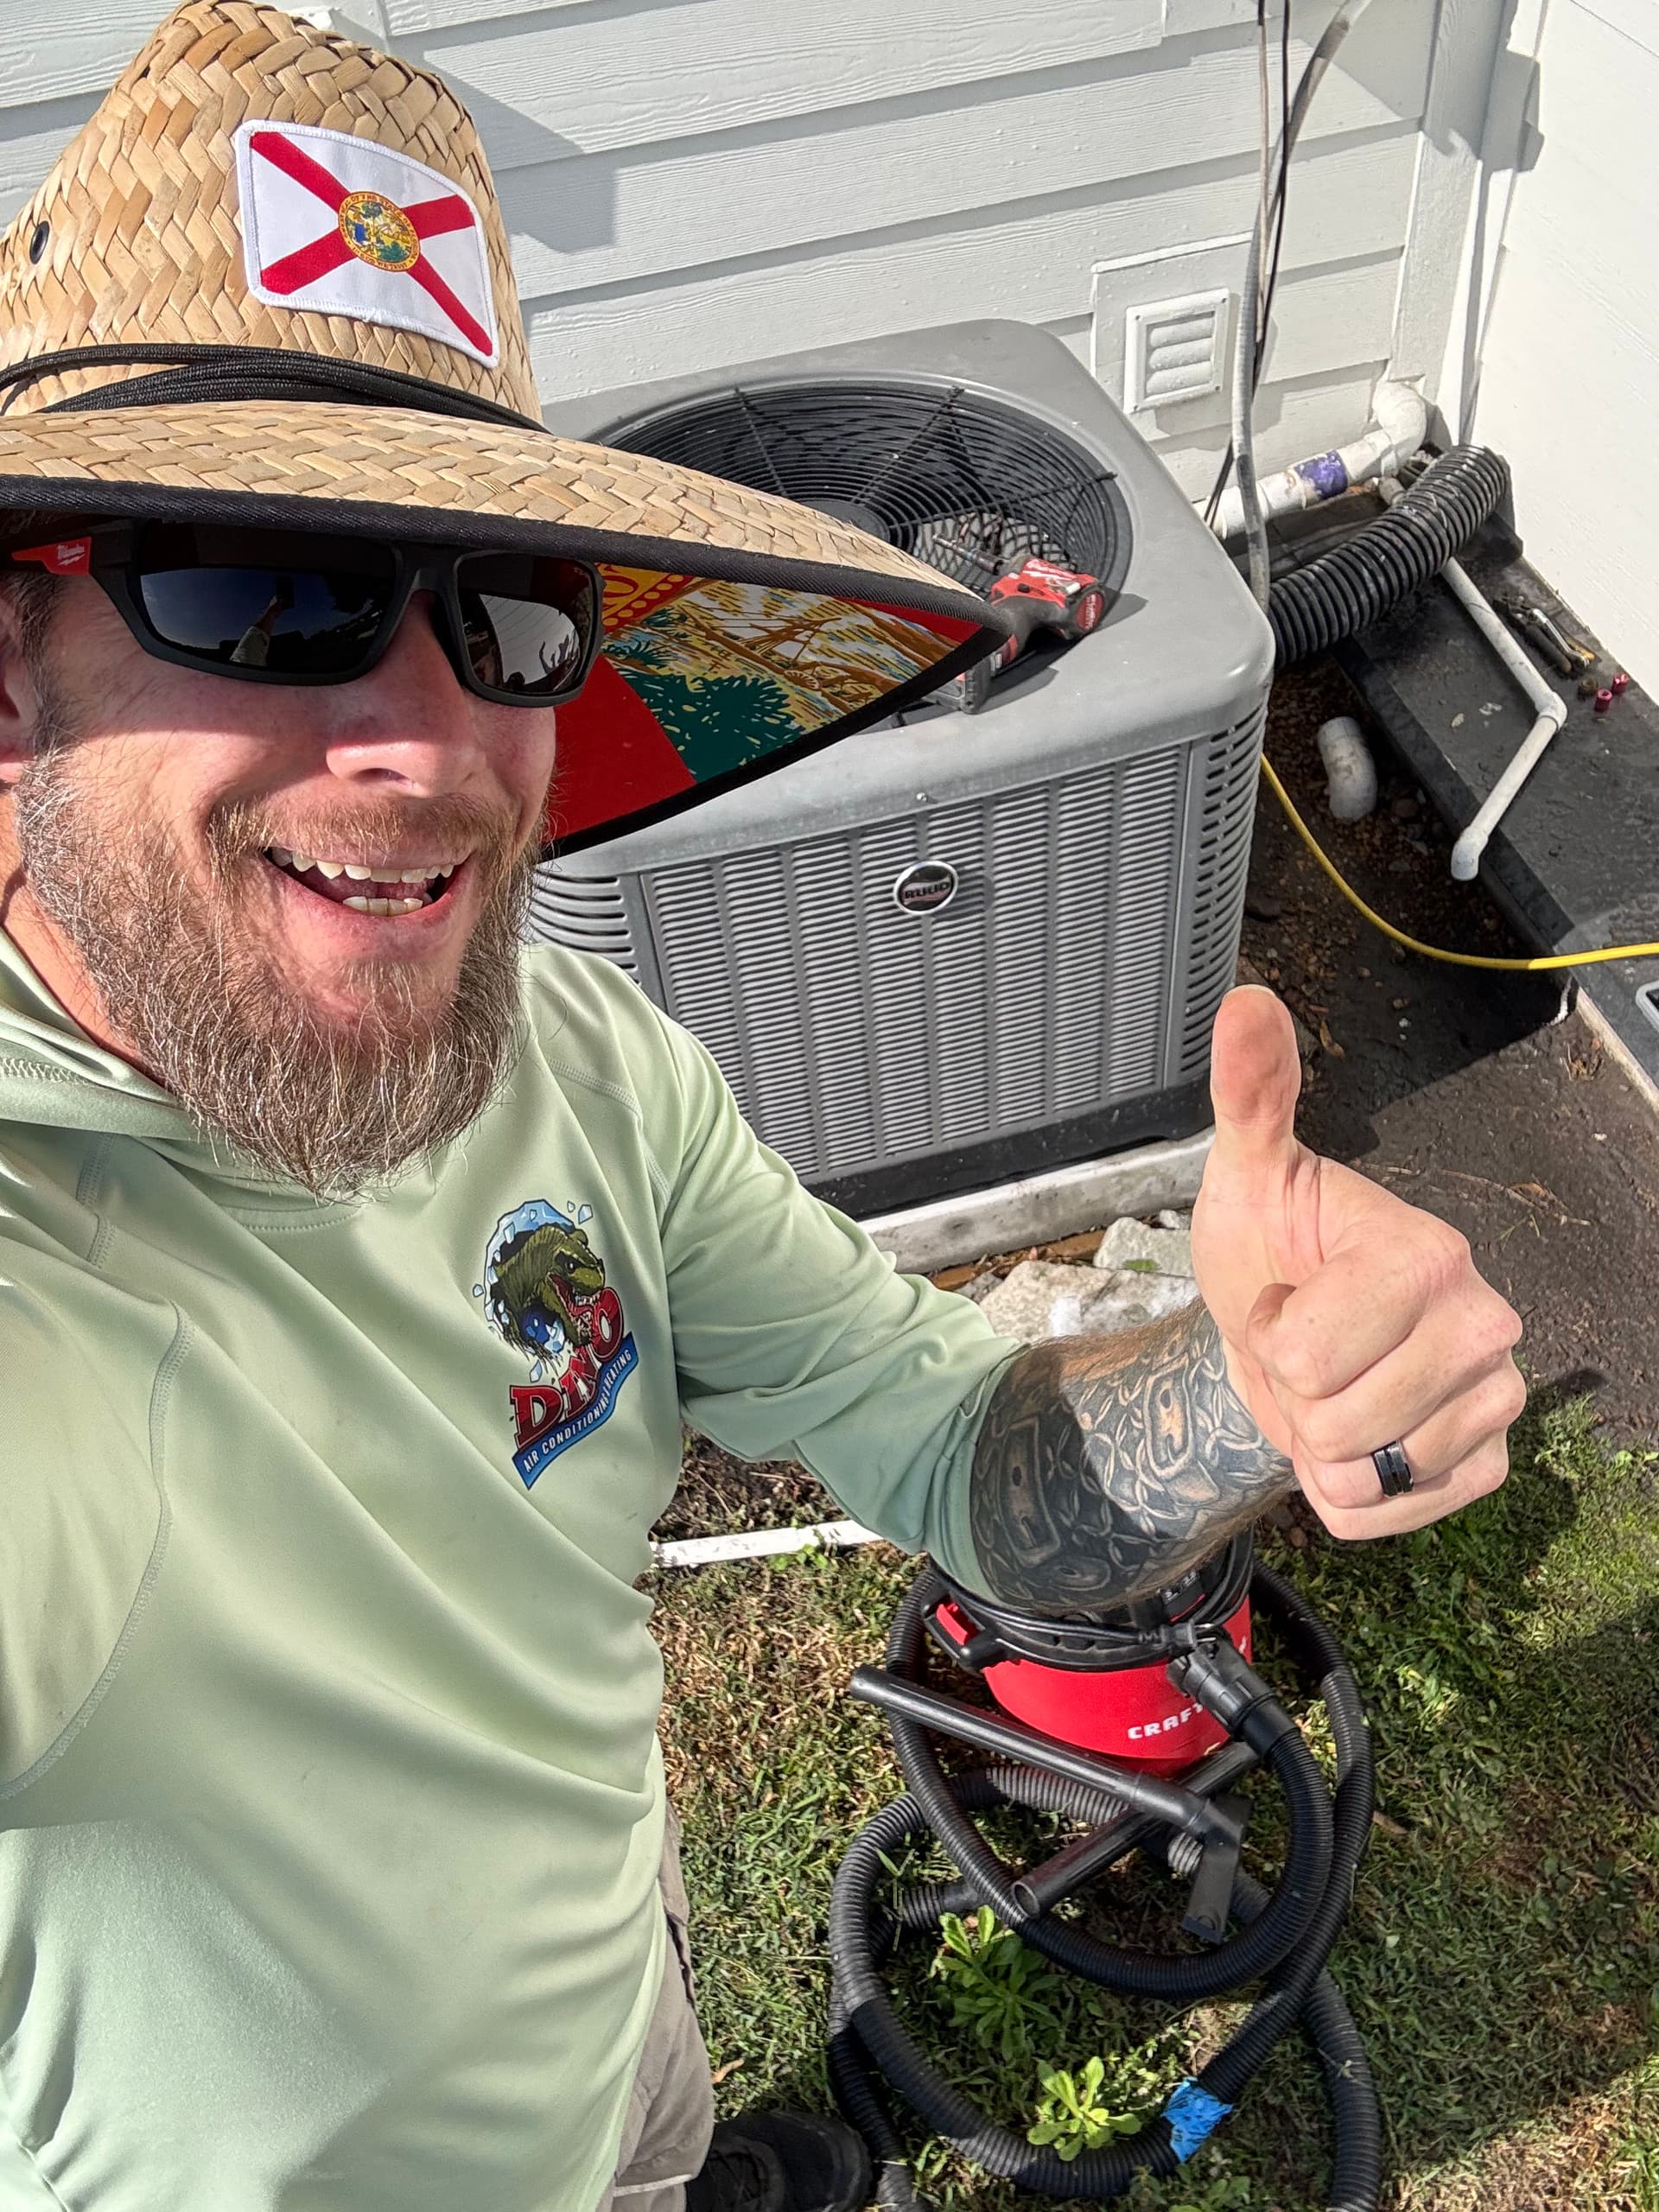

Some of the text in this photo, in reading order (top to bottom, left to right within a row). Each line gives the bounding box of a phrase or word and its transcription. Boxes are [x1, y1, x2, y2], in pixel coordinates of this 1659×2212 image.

[905, 881, 949, 899] RUUD
[510, 1287, 624, 1451] DINO
[523, 1450, 539, 1473] AIR
